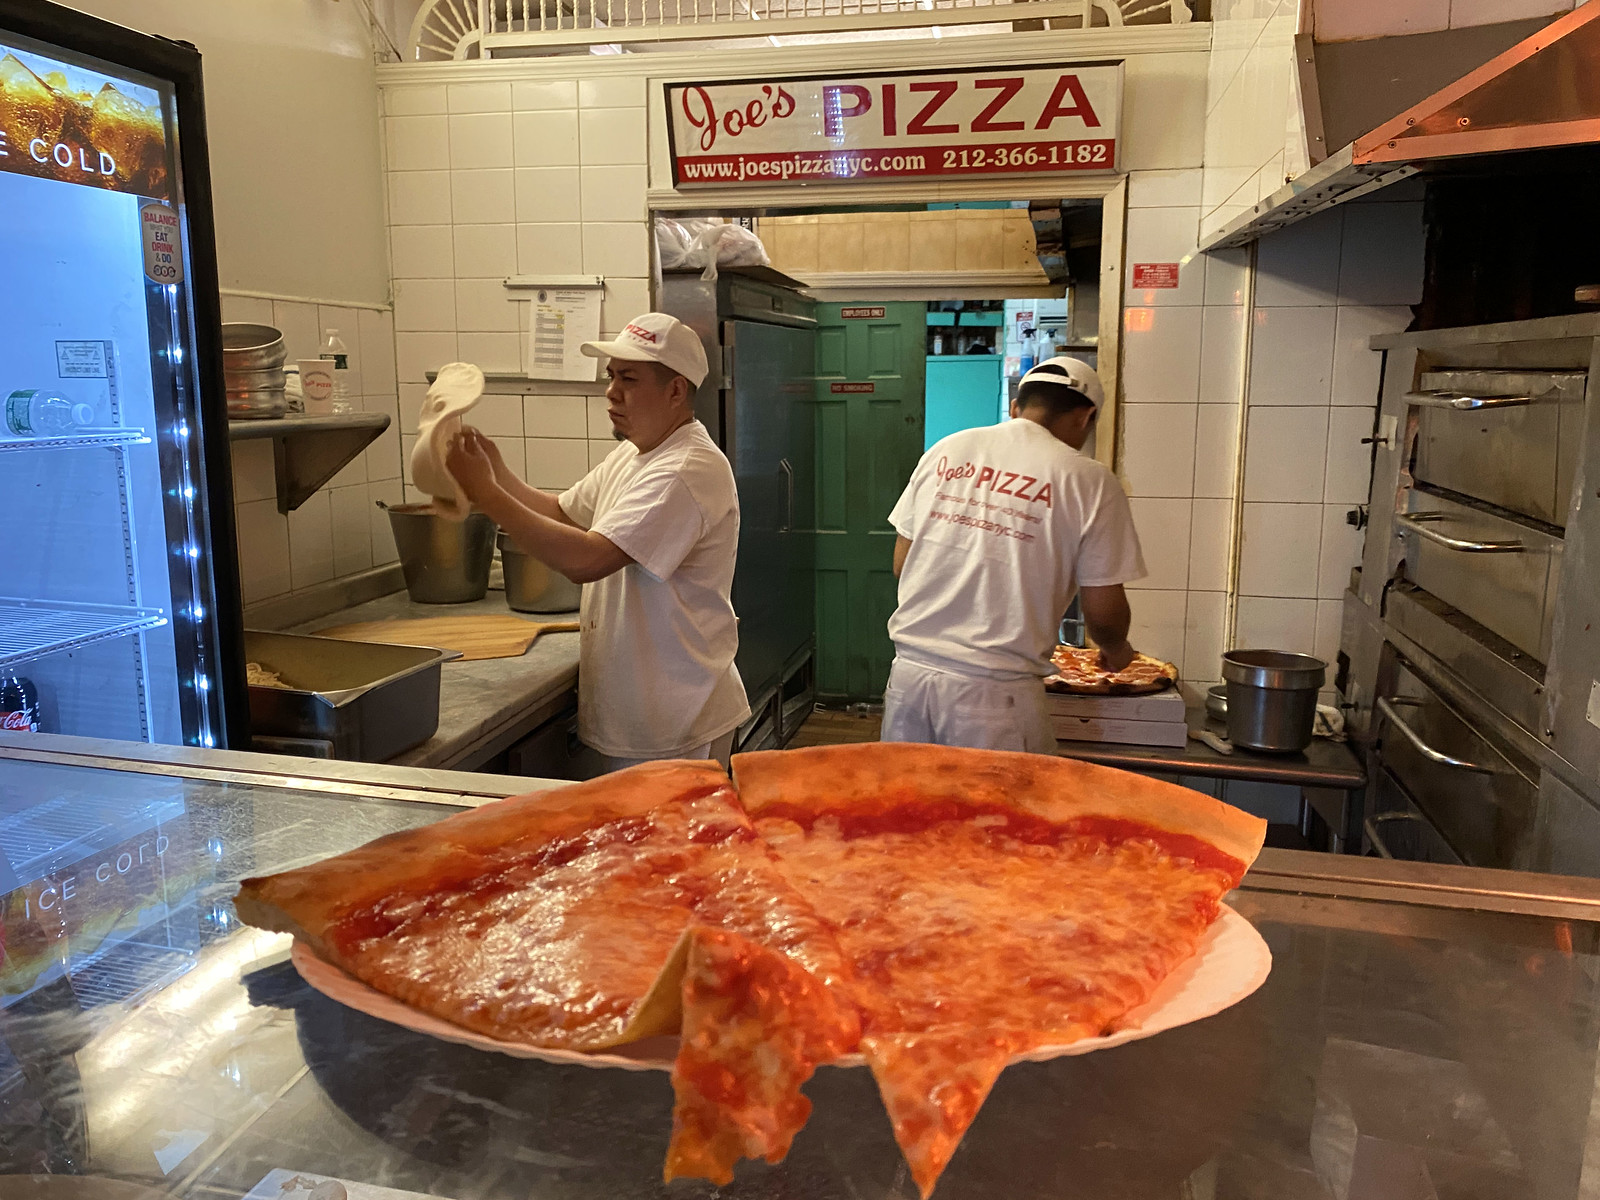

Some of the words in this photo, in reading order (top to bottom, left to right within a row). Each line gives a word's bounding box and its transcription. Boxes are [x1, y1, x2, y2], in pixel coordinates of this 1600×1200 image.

[682, 85, 796, 151] Joe's
[823, 75, 1101, 138] PIZZA
[29, 138, 116, 175] COLD
[943, 144, 1107, 168] 212-366-1182
[144, 212, 177, 227] BALANCE
[155, 231, 168, 242] EAT
[151, 241, 174, 254] DRINK
[161, 253, 172, 263] DO
[625, 324, 657, 344] PIZZA
[937, 456, 976, 487] Joe's
[975, 466, 1052, 509] PIZZA
